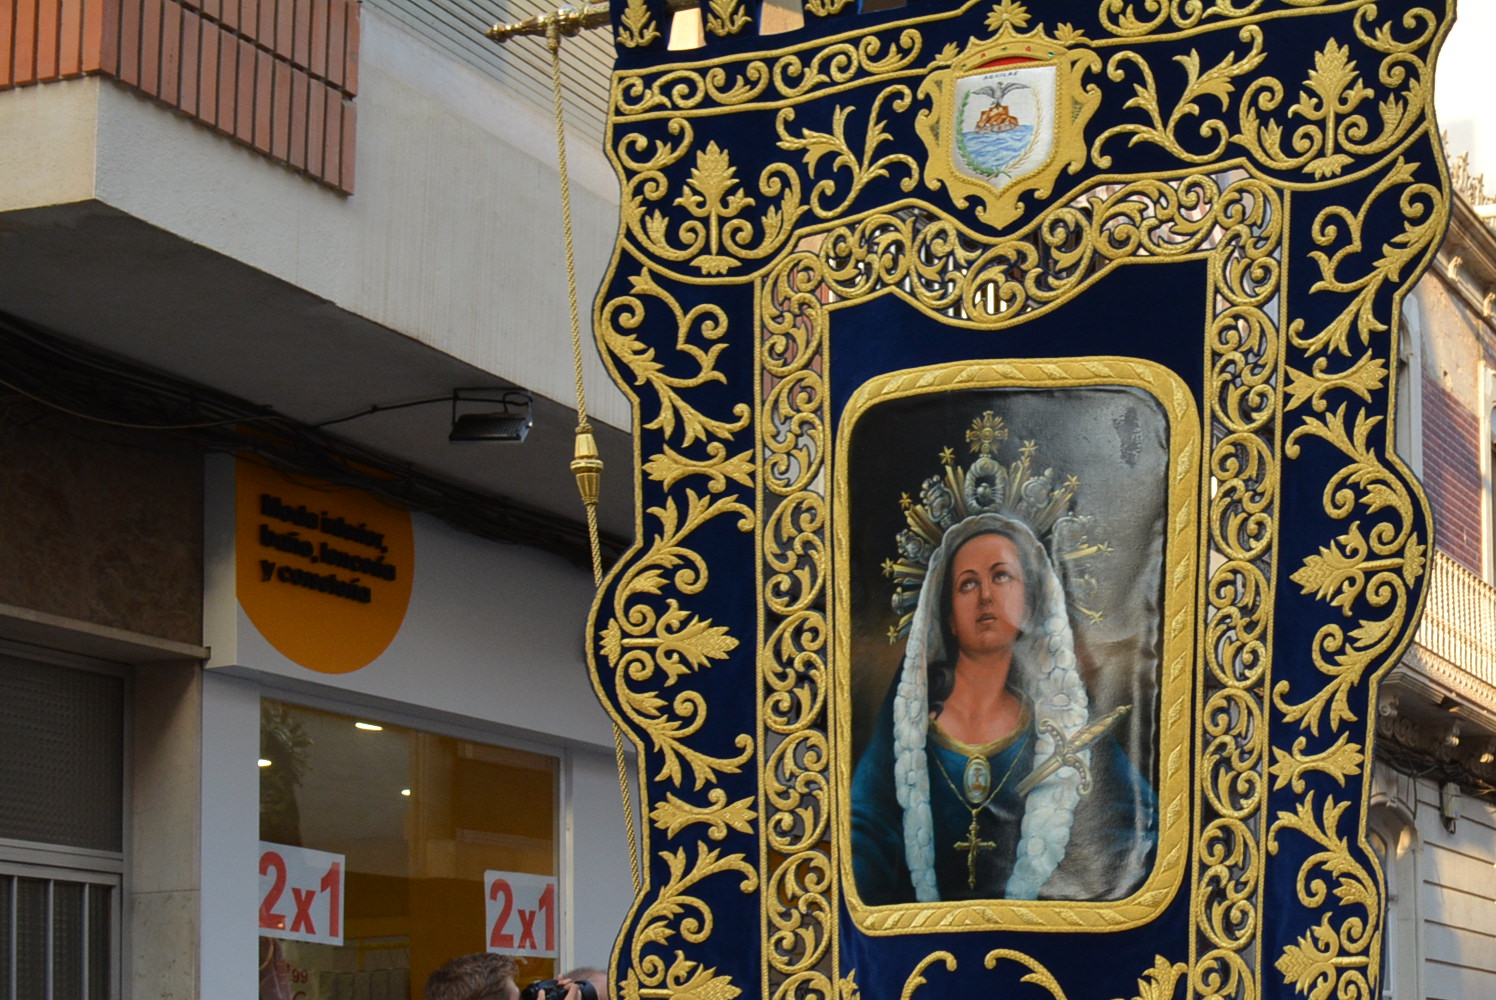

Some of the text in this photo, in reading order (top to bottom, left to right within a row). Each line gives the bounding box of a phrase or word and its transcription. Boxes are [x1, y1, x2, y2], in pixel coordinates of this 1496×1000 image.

[260, 560, 276, 582] y
[259, 851, 341, 937] 2x1
[490, 879, 555, 951] 2x1
